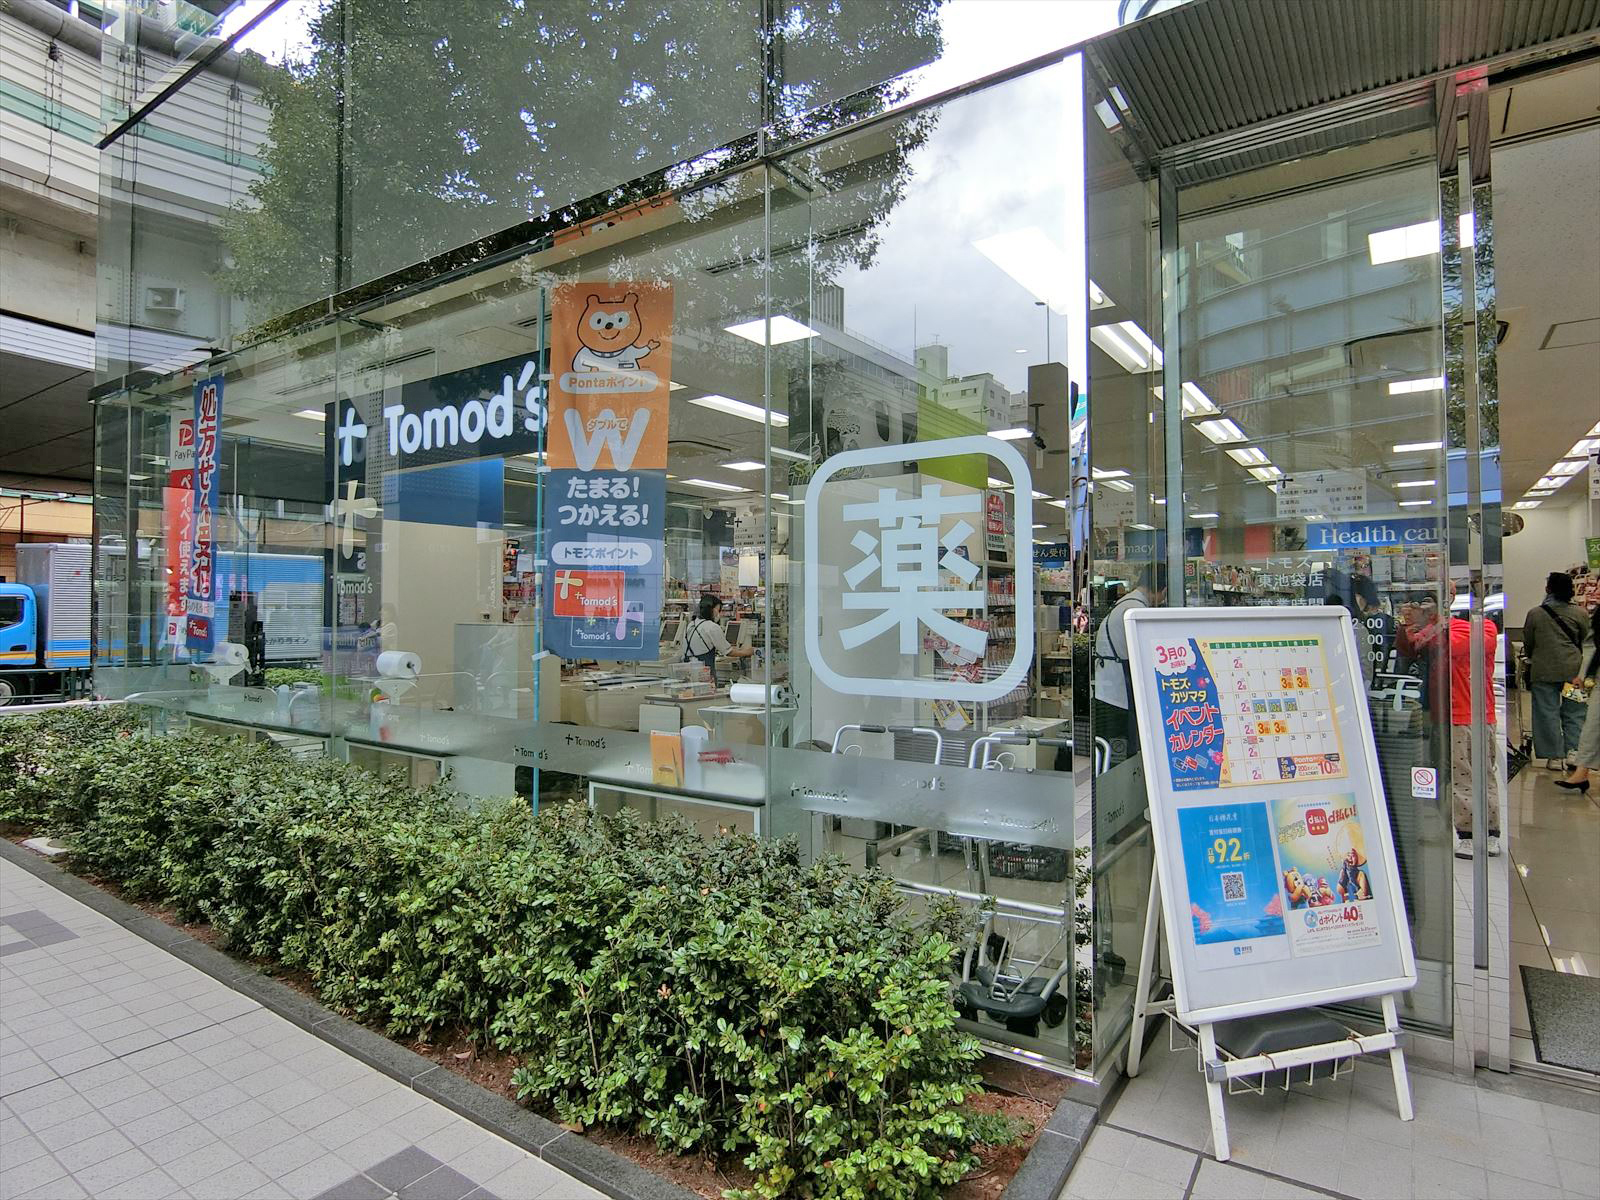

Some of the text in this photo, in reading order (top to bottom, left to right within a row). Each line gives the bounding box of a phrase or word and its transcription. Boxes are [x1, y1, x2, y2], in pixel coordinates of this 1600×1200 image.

[384, 361, 547, 456] Tomod's
[587, 417, 629, 432] ダブルで
[563, 407, 651, 472] W
[174, 450, 195, 459] PayPa
[567, 476, 640, 500] たまる!
[558, 503, 648, 526] つかえる!
[1320, 525, 1396, 544] Health
[564, 546, 638, 560] トモズポイント
[838, 484, 988, 658] 薬
[1258, 572, 1324, 587] 東池袋店
[580, 596, 618, 606] Tomod's
[1156, 646, 1187, 664] 3月の
[1171, 690, 1206, 704] カツマタ
[1167, 702, 1220, 731] イベント
[574, 736, 606, 750] Tomod's
[1169, 724, 1224, 752] カレンダー
[520, 748, 548, 760] Tomd's
